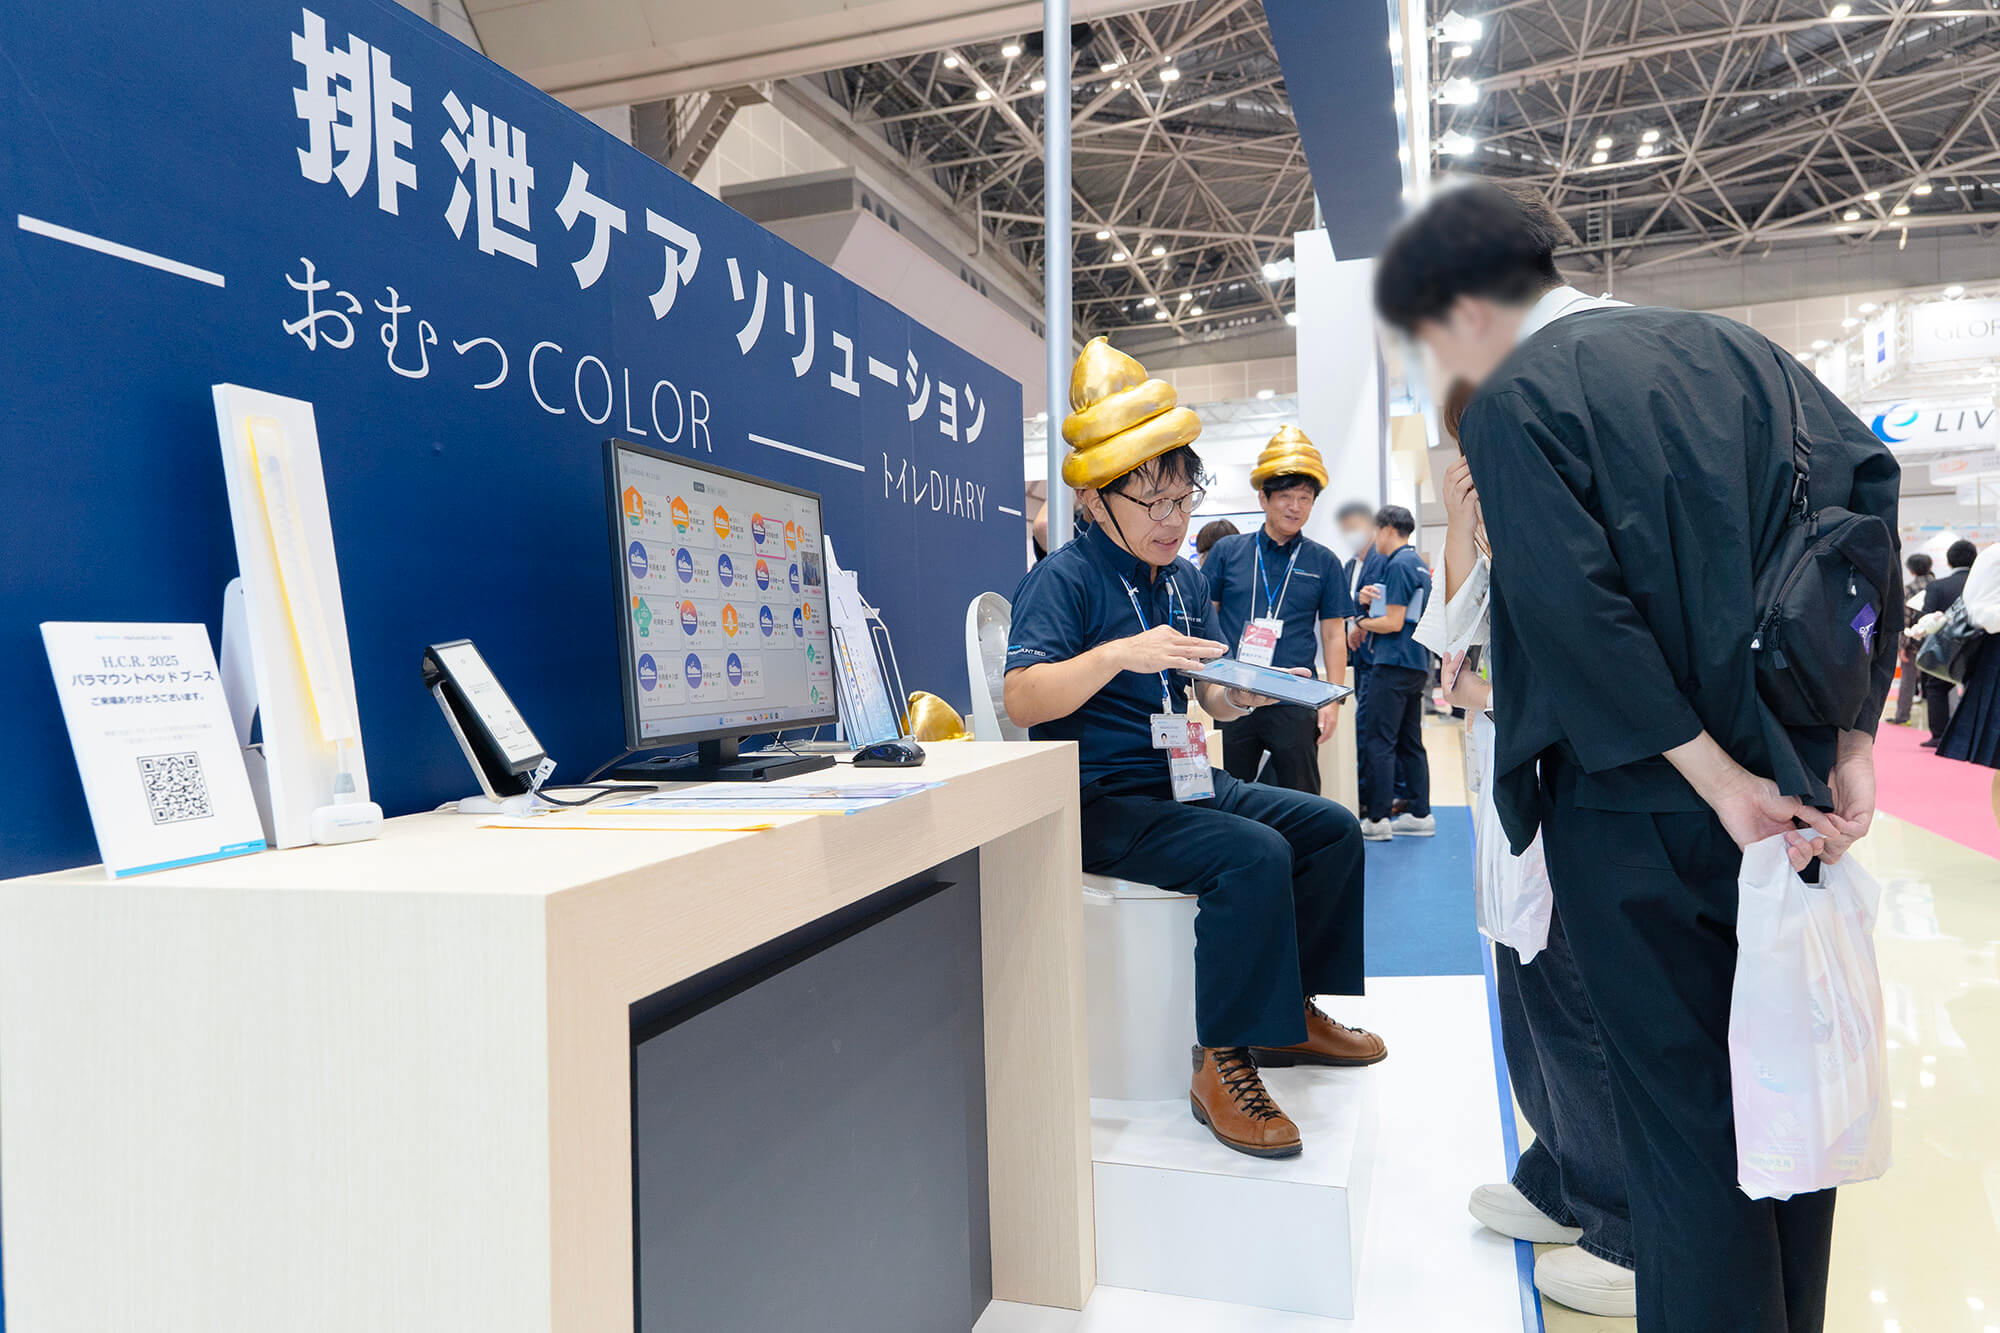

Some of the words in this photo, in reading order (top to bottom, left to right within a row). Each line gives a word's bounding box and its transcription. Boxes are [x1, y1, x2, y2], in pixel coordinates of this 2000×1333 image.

[291, 7, 986, 443] 排泄ケアソリューション
[282, 257, 712, 453] おむつCOLOR
[883, 452, 987, 522] トイレDIARY
[102, 656, 145, 668] H.C.R.
[147, 655, 179, 667] 2025
[181, 671, 214, 682] ブース
